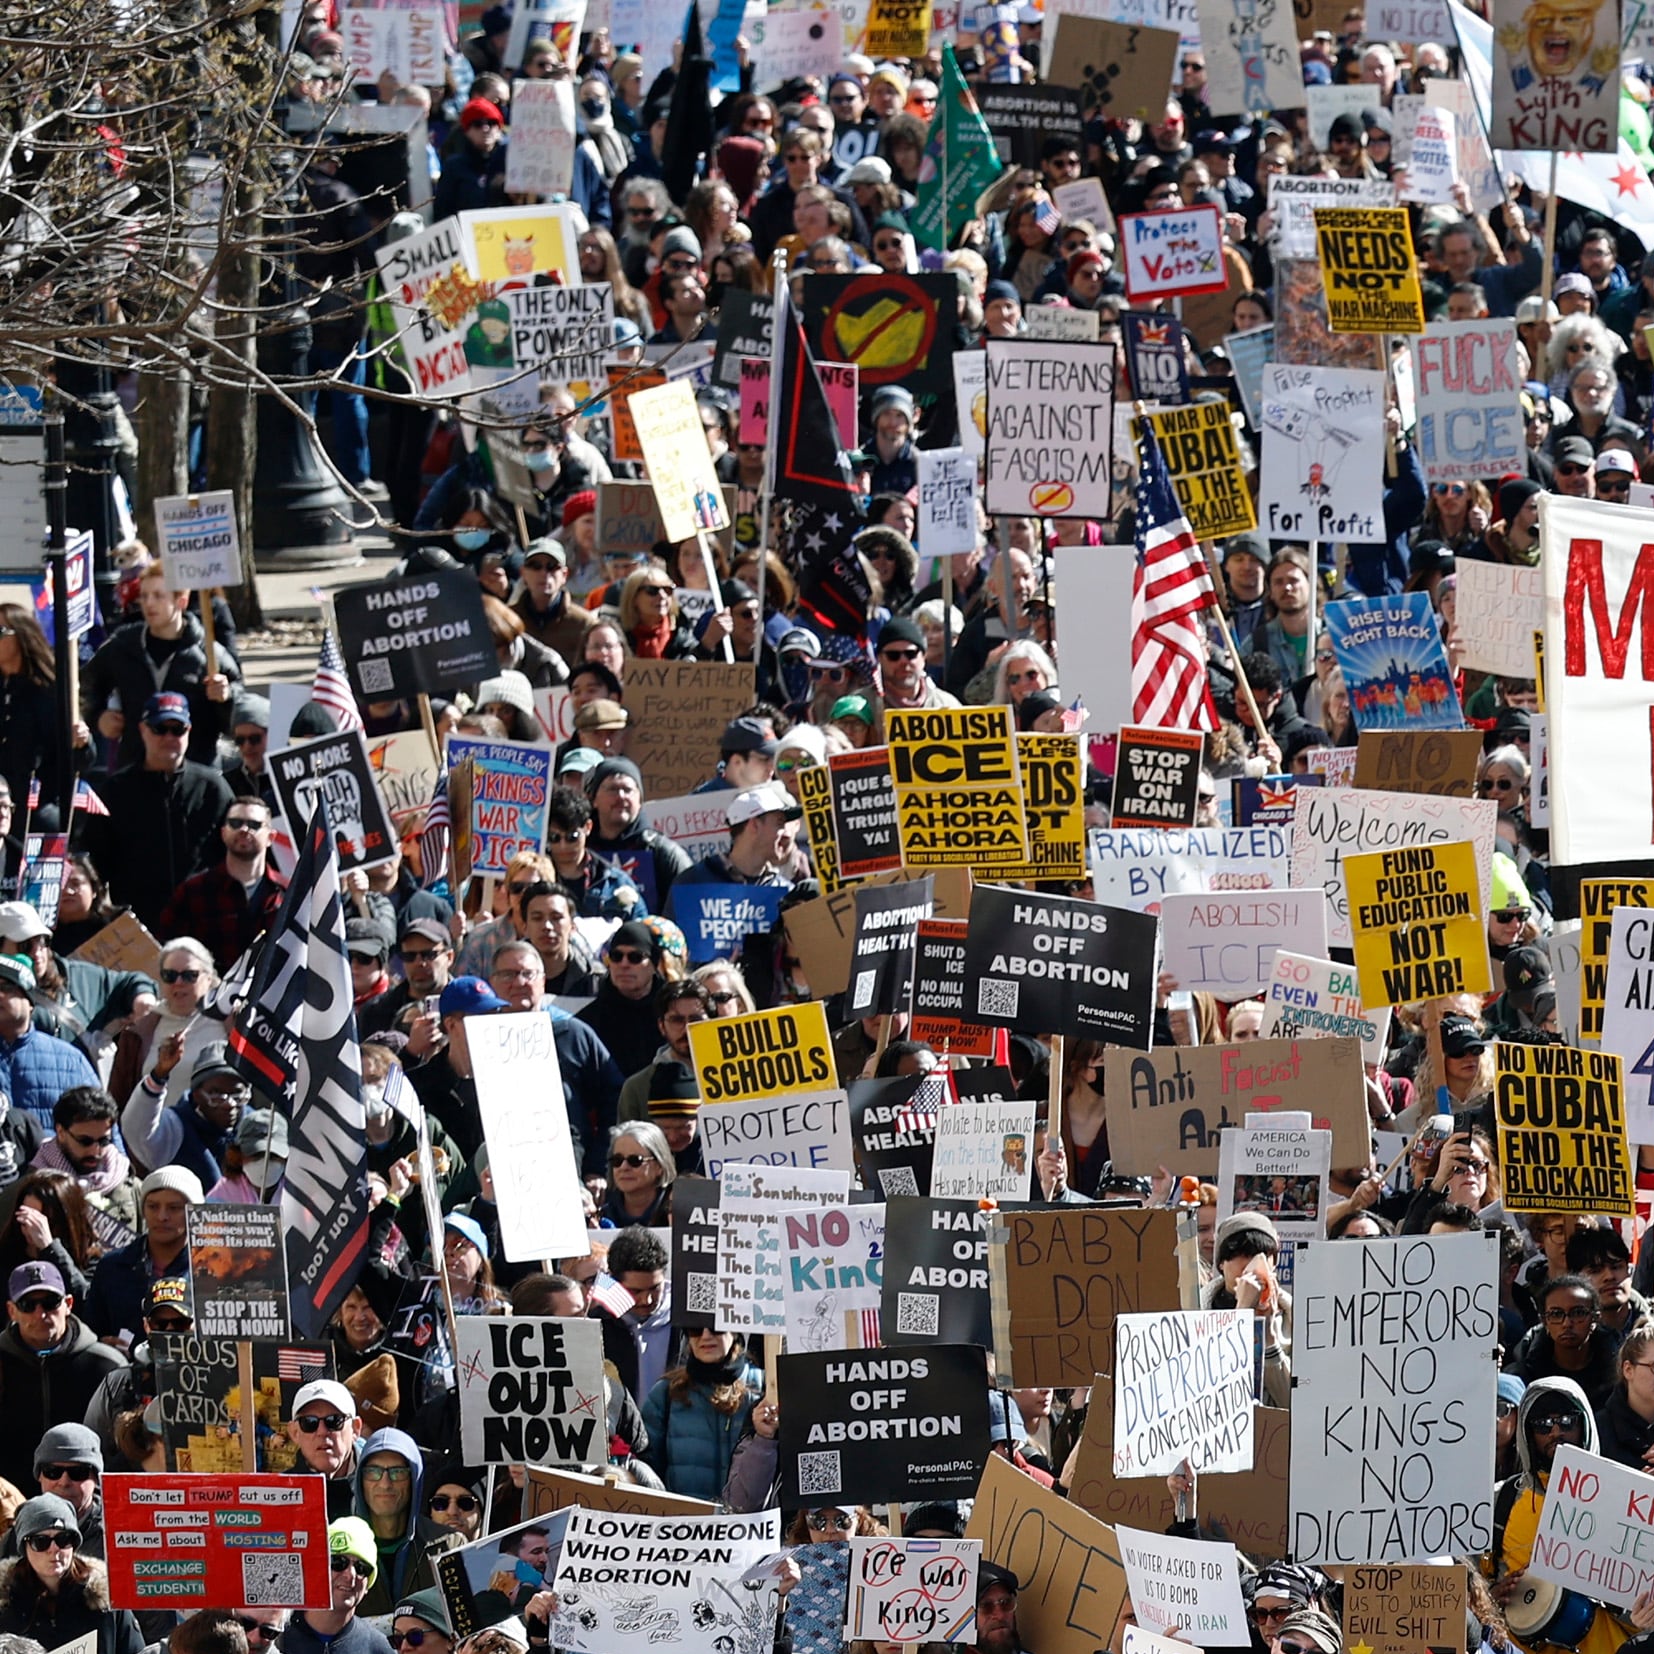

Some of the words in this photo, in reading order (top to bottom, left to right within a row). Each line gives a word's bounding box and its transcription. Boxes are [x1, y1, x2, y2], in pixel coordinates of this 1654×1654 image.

[1320, 230, 1409, 271] NEEDS
[1333, 272, 1406, 289] NOT
[1329, 300, 1360, 319] WAR
[1361, 301, 1419, 320] MACHINE
[990, 360, 1111, 392] VETERANS
[991, 404, 1102, 440] AGAINST
[990, 447, 1108, 484] FASCISM
[167, 534, 232, 553] CHICAGO
[1383, 849, 1434, 876] FUND
[1375, 872, 1448, 901] PUBLIC
[1013, 904, 1107, 933] HANDS
[1359, 892, 1469, 928] EDUCATION
[1033, 932, 1085, 954] OFF
[1389, 923, 1447, 965] NOT
[990, 955, 1129, 990] ABORTION
[1382, 958, 1464, 1003] WAR!
[1362, 1242, 1436, 1287] NO
[1306, 1289, 1495, 1348] EMPERORS
[489, 1324, 567, 1368] ICE
[1360, 1348, 1436, 1396] NO
[487, 1371, 573, 1415] OUT
[484, 1417, 595, 1463] NOW
[1325, 1400, 1467, 1455] KINGS
[1362, 1454, 1432, 1503] NO
[1296, 1503, 1490, 1560] DICTATORS
